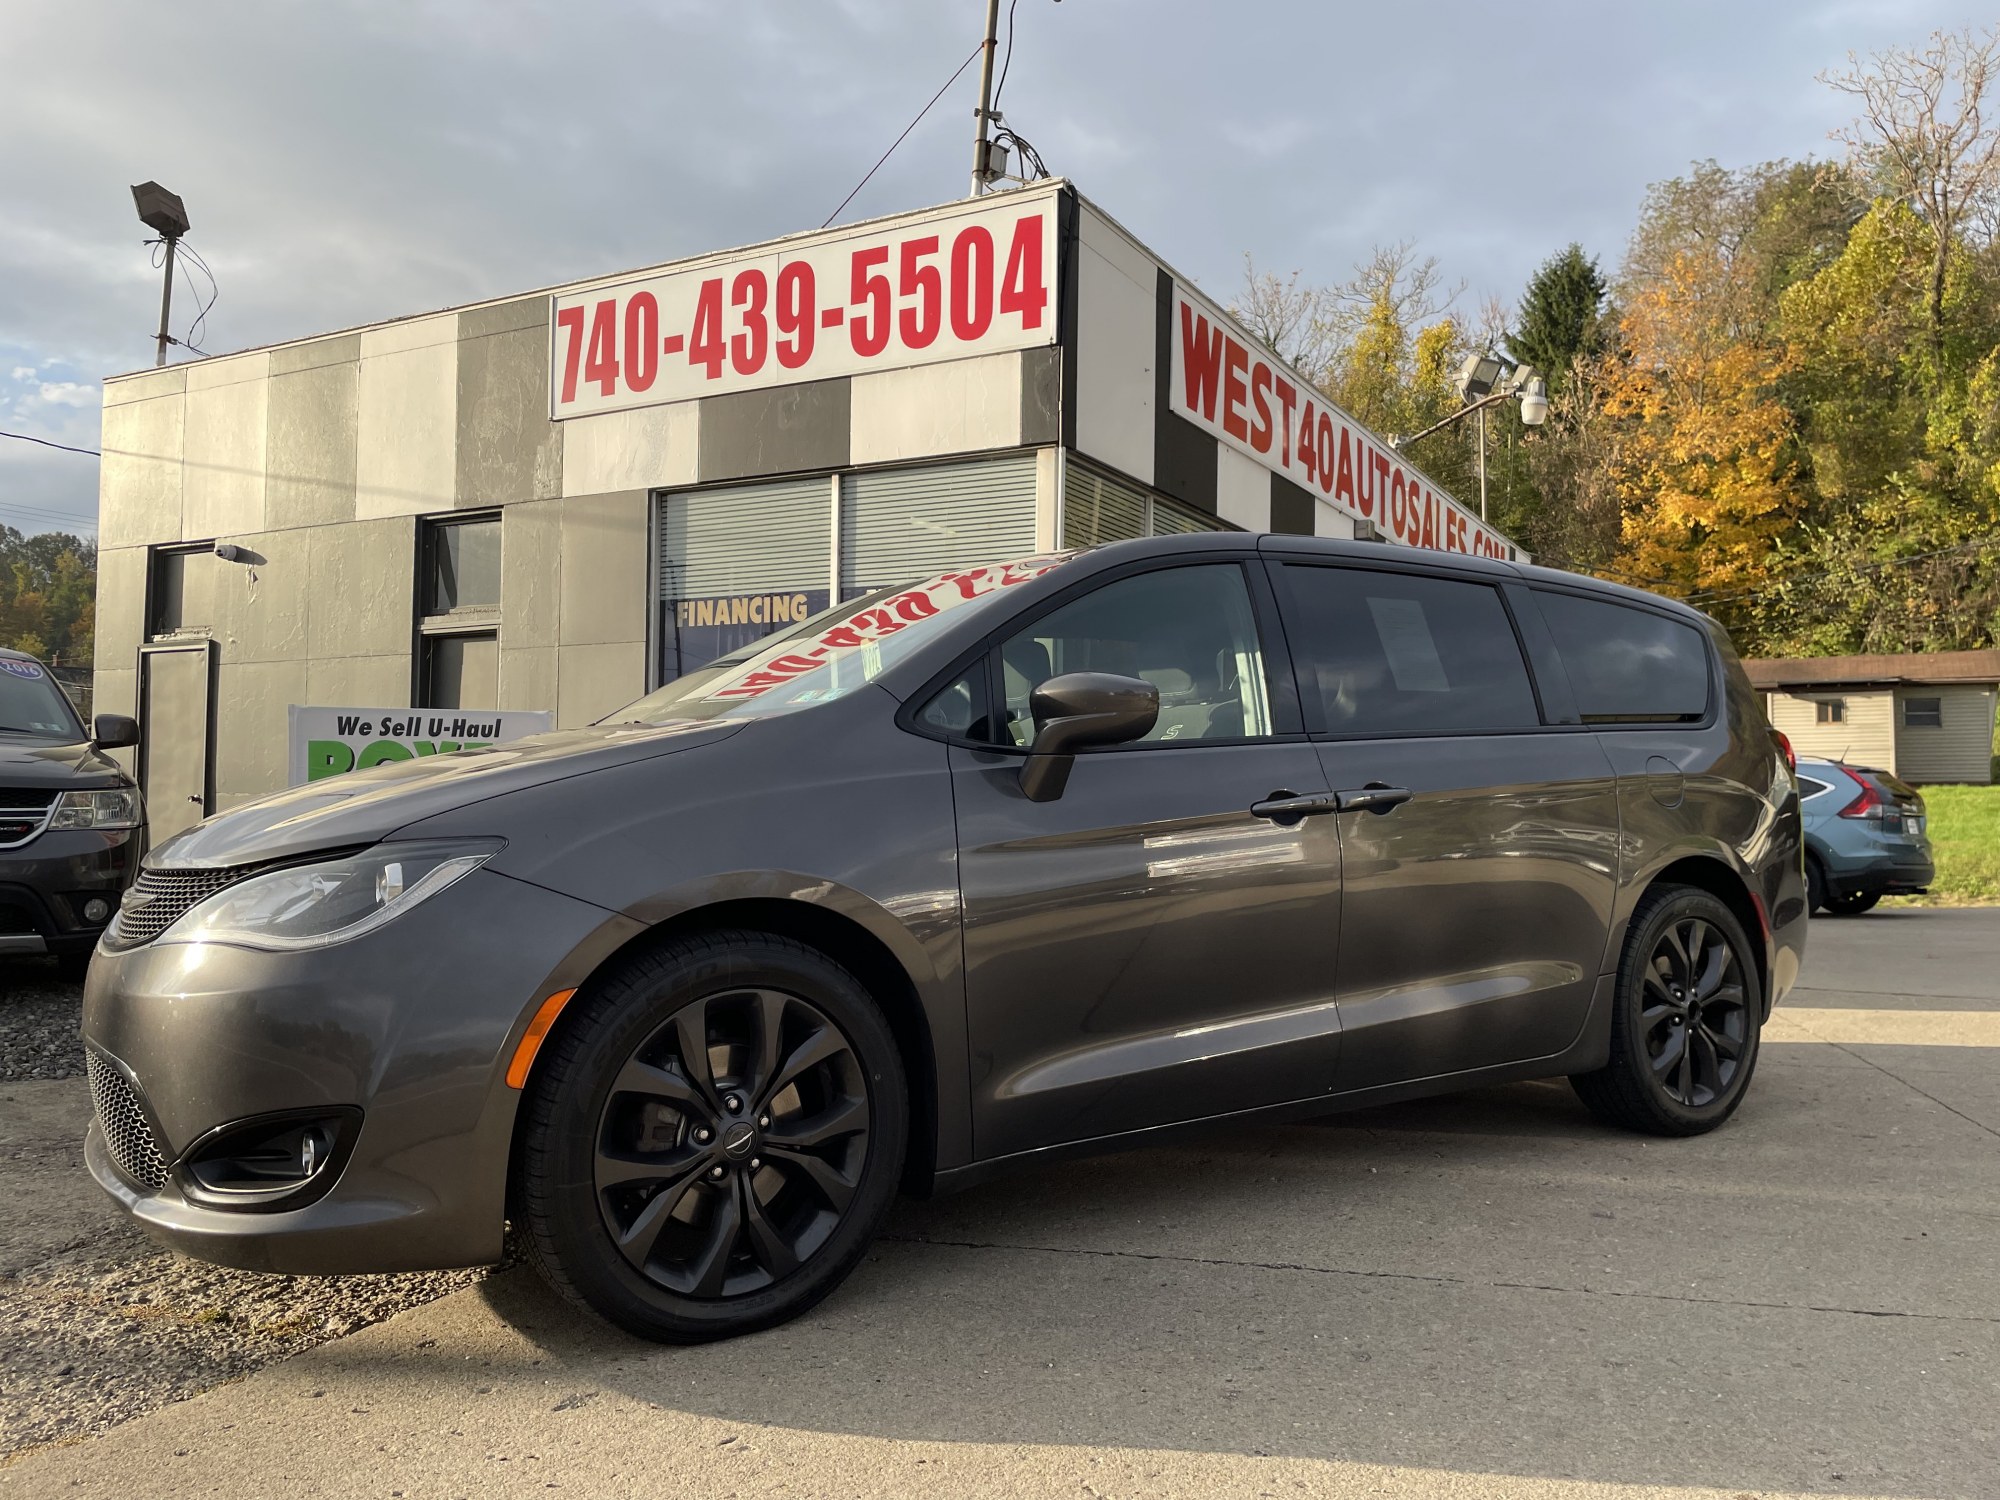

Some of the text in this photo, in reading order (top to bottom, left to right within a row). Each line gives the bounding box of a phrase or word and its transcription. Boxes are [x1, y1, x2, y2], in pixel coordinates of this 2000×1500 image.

[557, 214, 1048, 404] 740-439-5504
[1180, 300, 1505, 560] WEST40AUTOSALES
[677, 594, 808, 627] FINANCING
[337, 716, 502, 738] We Sell U-Haul
